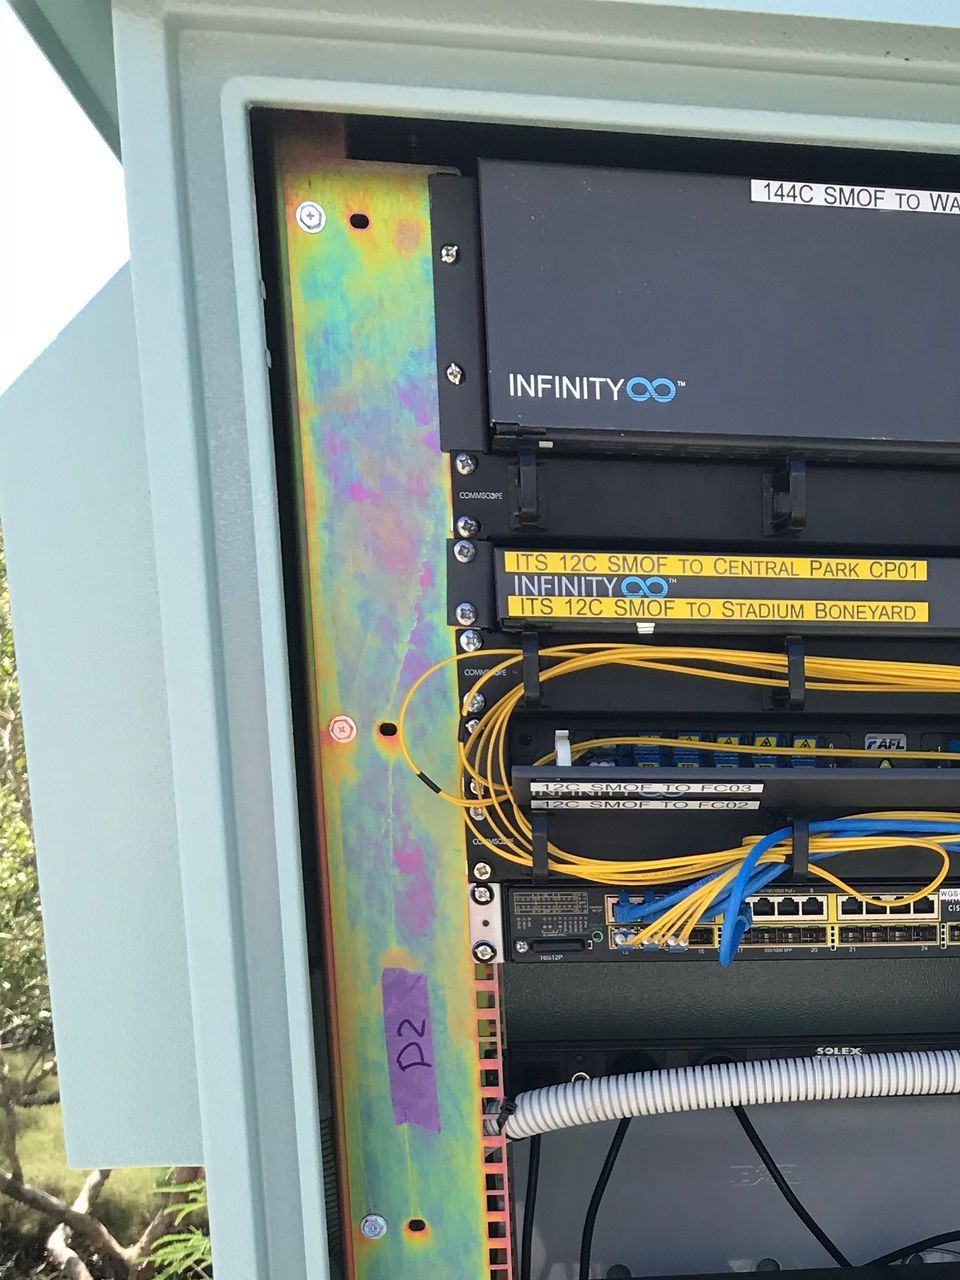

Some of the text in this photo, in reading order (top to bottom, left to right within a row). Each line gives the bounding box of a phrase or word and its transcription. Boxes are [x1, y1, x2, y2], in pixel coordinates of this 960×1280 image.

[763, 181, 814, 204] 144C
[823, 186, 886, 208] SMOF
[894, 192, 921, 210] TO
[508, 373, 626, 402] INFINITY
[459, 491, 503, 499] COMMSCOPE
[515, 553, 918, 579] ITS 12C SMOF TO CENTRAL PARK CP01
[513, 575, 618, 597] INFINITY
[520, 597, 917, 621] ITS 12C SMOF TO STADIUM BONEYARD
[877, 738, 905, 750] AFL
[541, 783, 752, 793] 12C SMOF TO FC03
[542, 800, 749, 810] 12C SMOF TO FC02
[396, 1018, 433, 1072] D2
